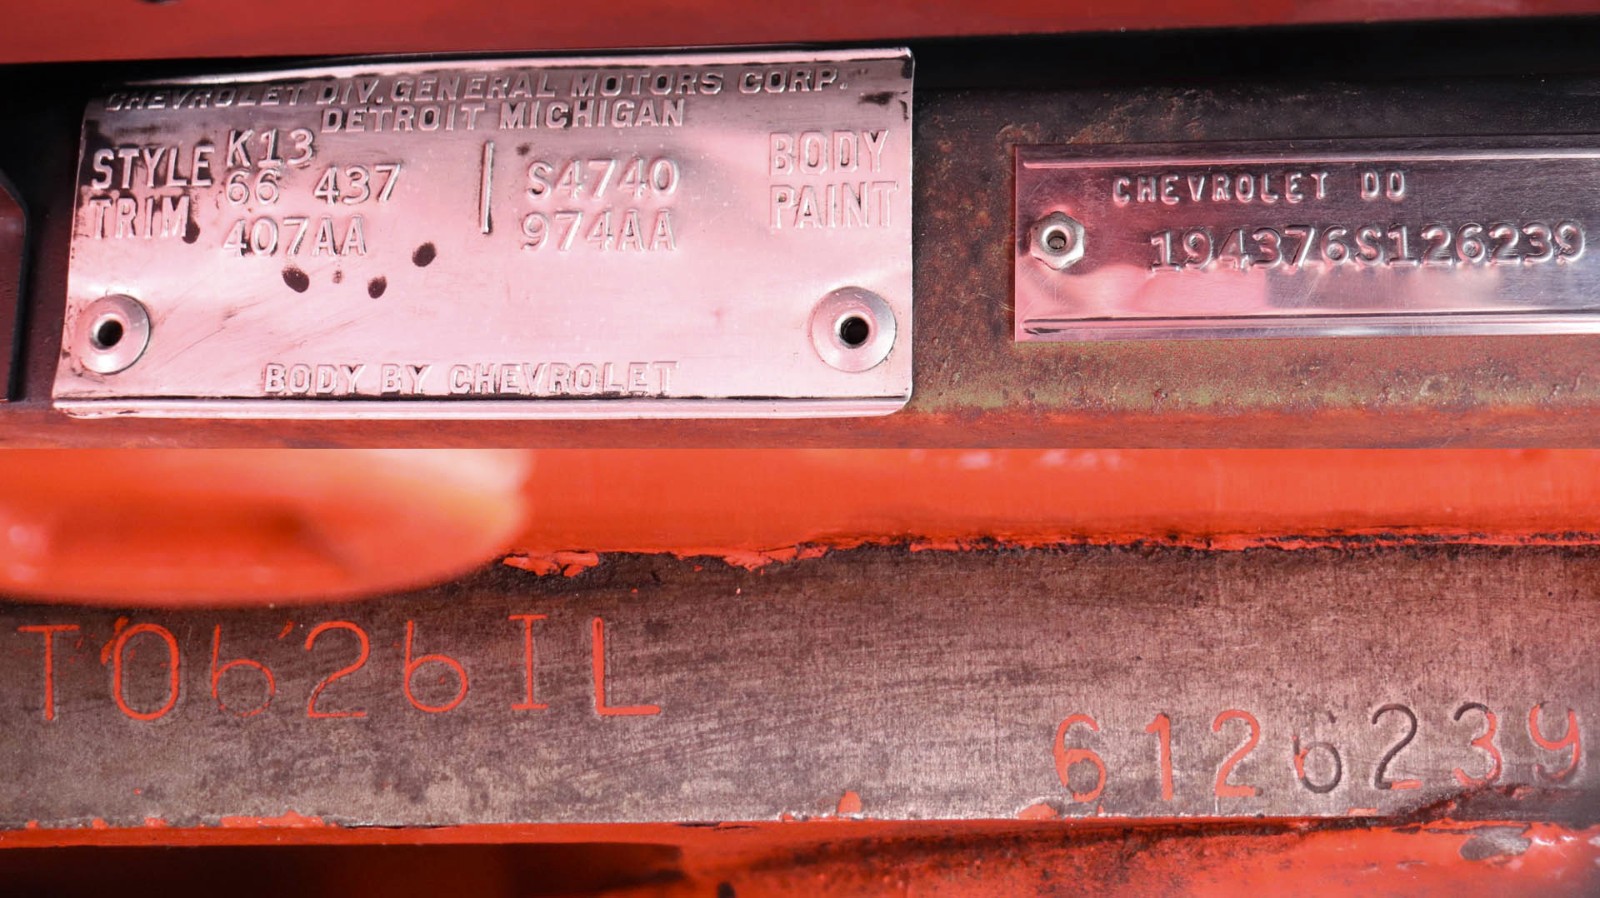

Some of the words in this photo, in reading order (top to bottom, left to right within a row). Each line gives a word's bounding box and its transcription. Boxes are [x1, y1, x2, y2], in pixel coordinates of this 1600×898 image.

[106, 84, 307, 112] CHEVROLET
[569, 70, 724, 99] MOTORS
[738, 67, 849, 95] CORP.
[320, 103, 486, 134] DETROIT
[498, 99, 685, 130] MICHIGAN
[91, 144, 214, 191] STYLE
[225, 168, 280, 205] 66
[312, 162, 402, 204] 437
[525, 157, 680, 201] S4740
[768, 130, 890, 176] BODY
[225, 127, 315, 167] K13
[1112, 170, 1328, 206] CHEVROLET
[89, 192, 191, 241] TRIM
[221, 215, 367, 257] 407AA
[520, 208, 679, 251] 974AA
[768, 180, 898, 229] PAINT
[1149, 222, 1588, 272] 194376S126239
[263, 363, 366, 395] BODY
[380, 363, 434, 395] BY
[446, 361, 680, 397] CHEVROLET
[1052, 702, 1582, 800] 6126239
